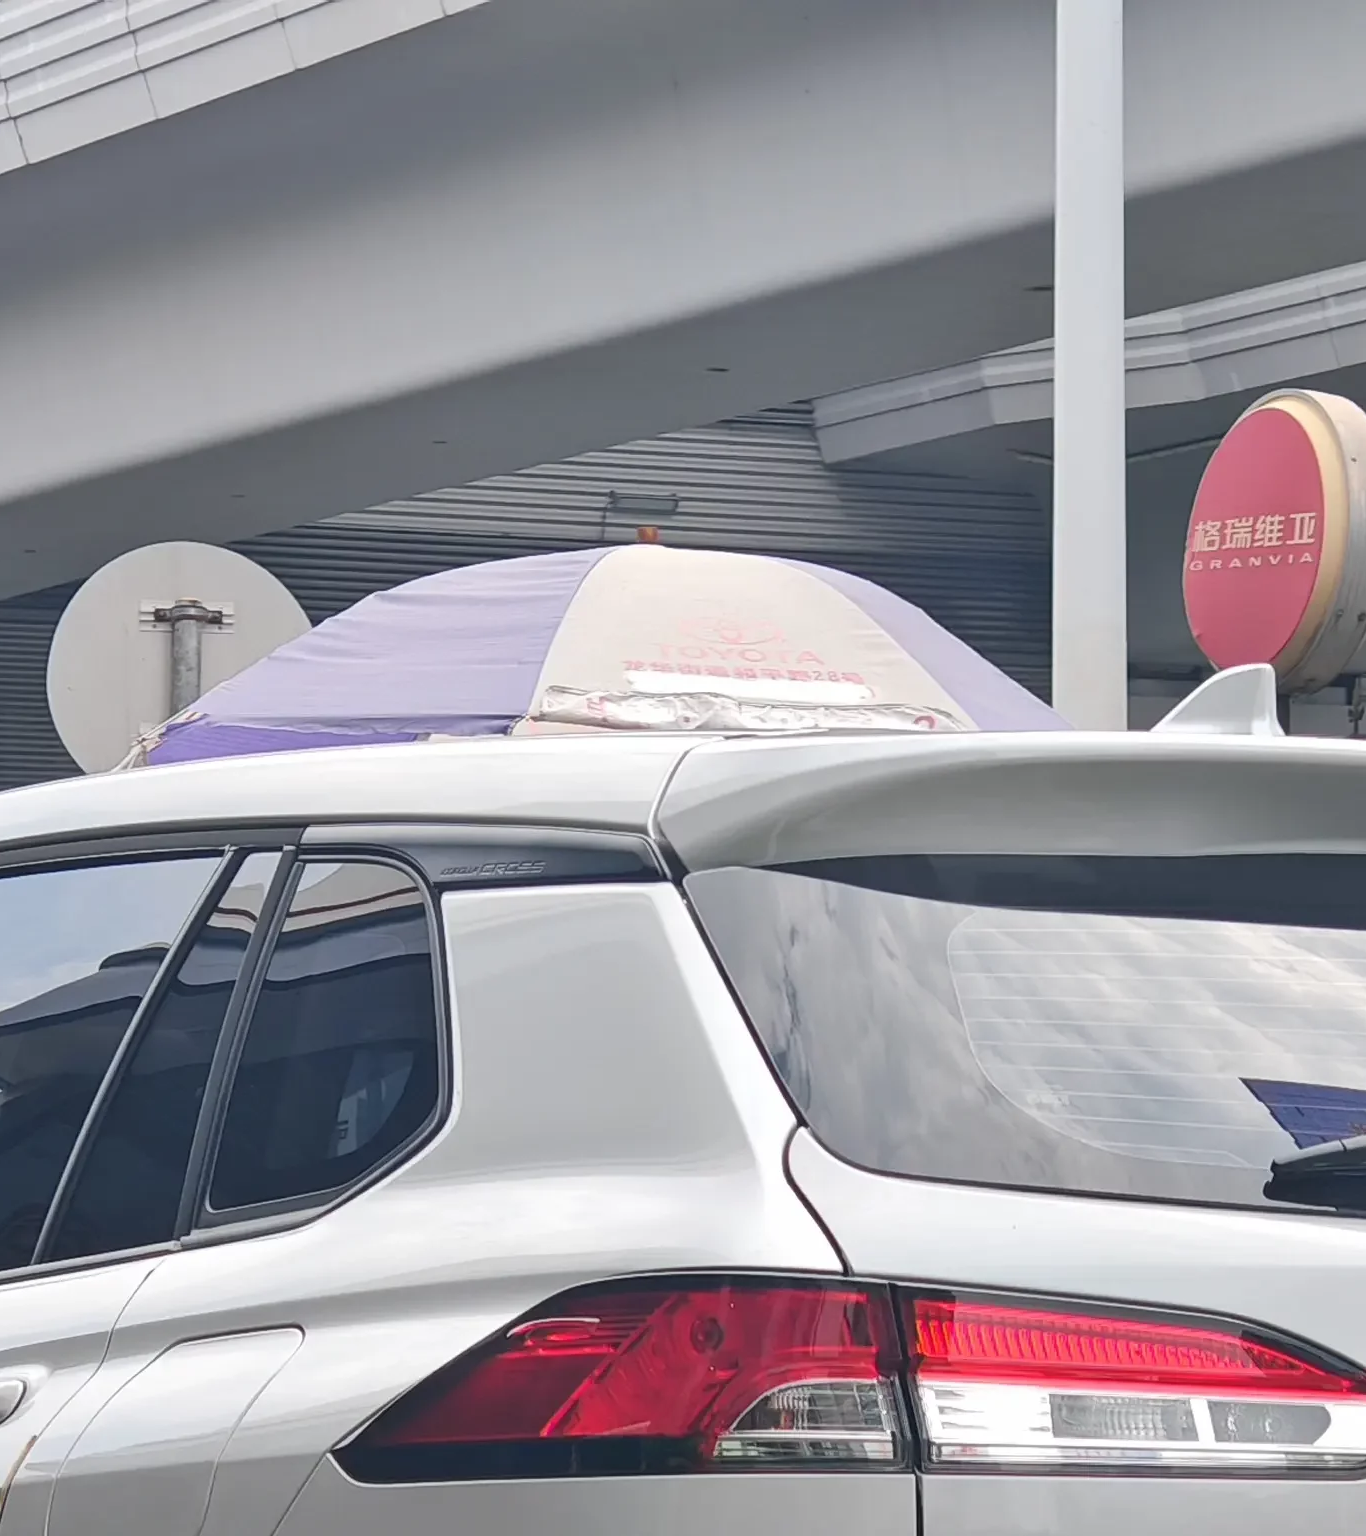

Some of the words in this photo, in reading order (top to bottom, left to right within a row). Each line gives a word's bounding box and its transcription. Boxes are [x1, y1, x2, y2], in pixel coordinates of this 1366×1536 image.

[1191, 512, 1318, 553] 格瑞维亚
[1189, 552, 1315, 571] GRANVIA
[653, 643, 826, 666] TOYOTA
[479, 859, 546, 876] CROSS
